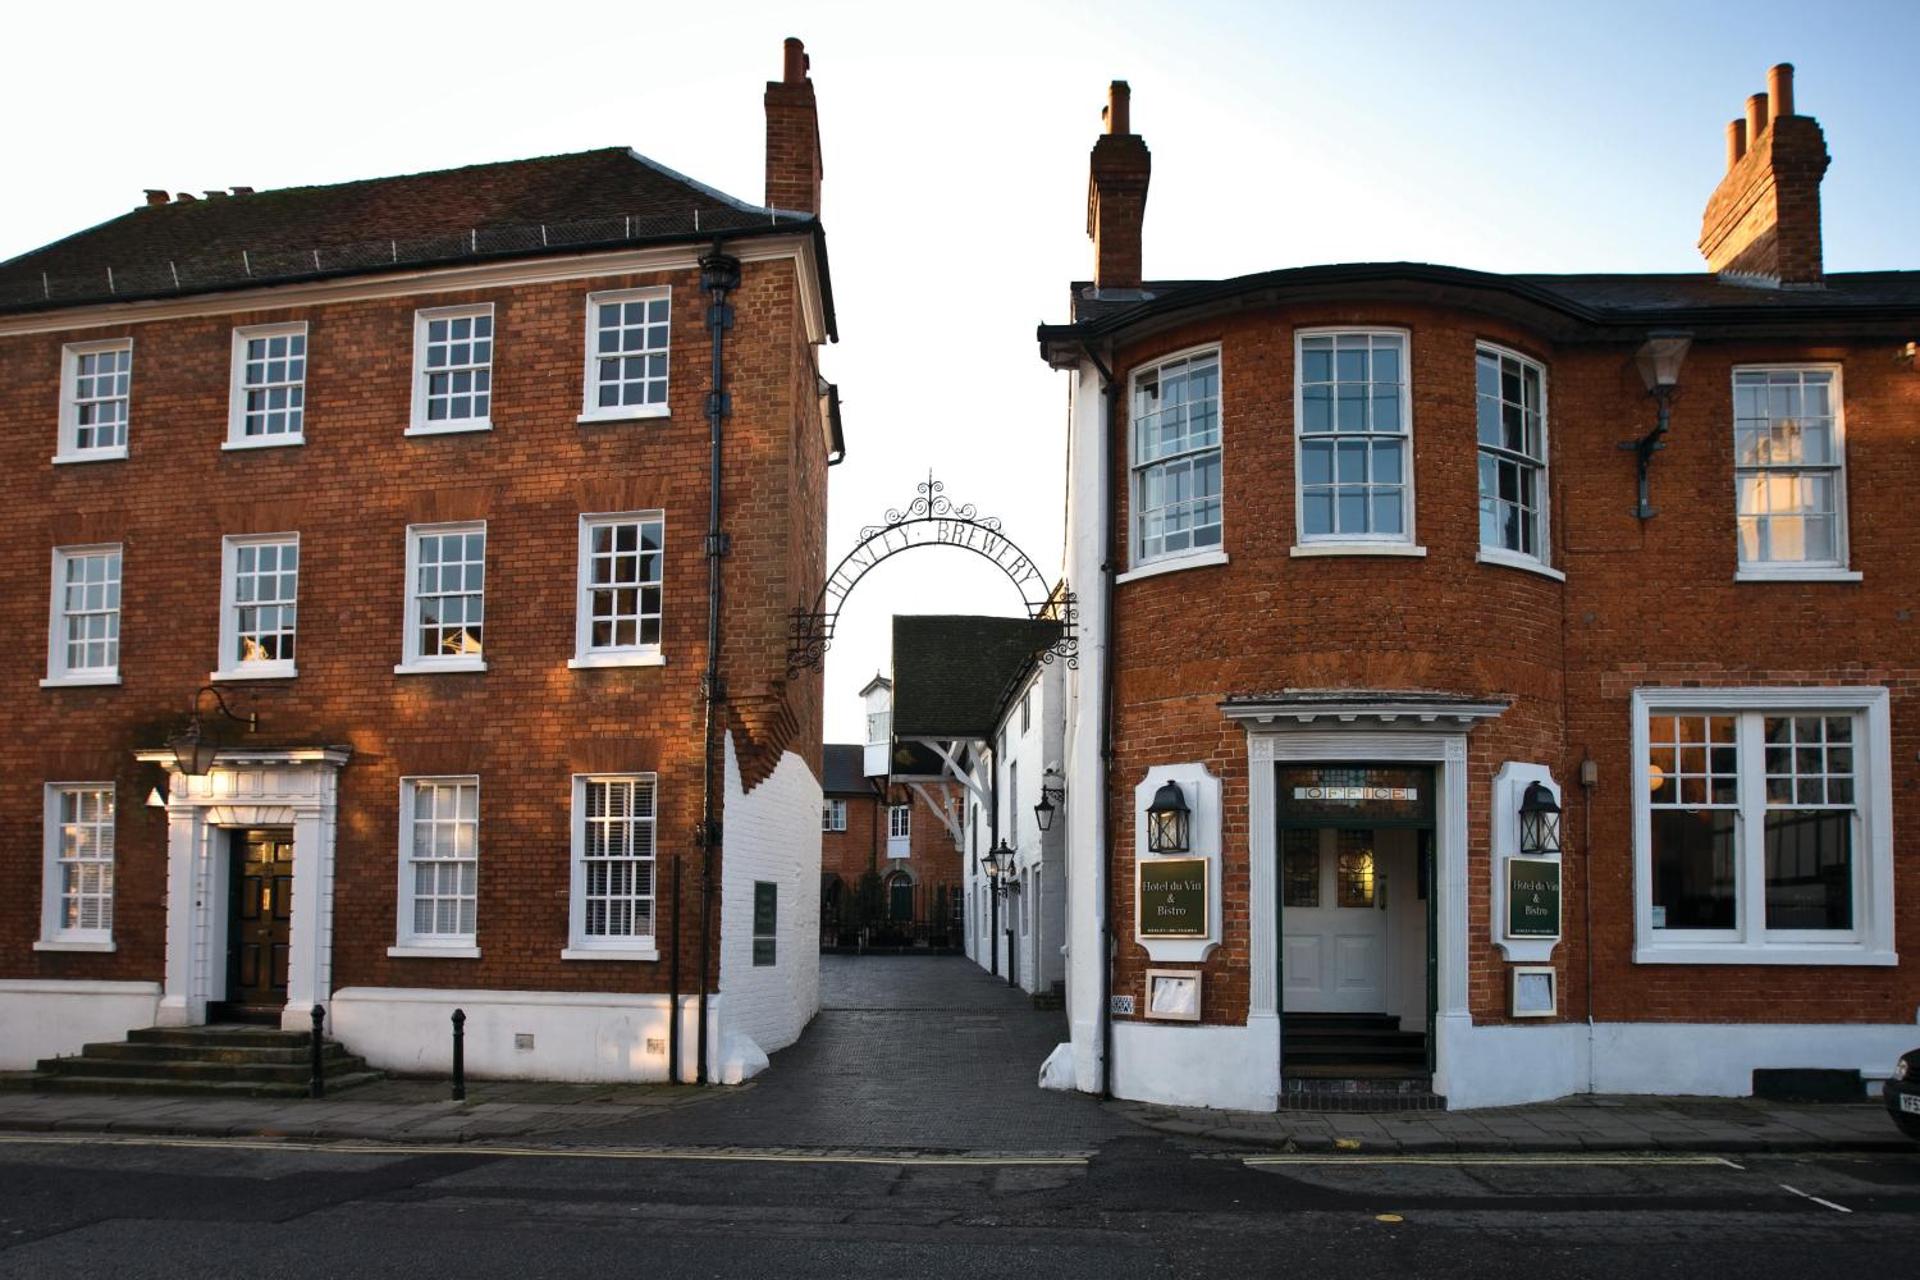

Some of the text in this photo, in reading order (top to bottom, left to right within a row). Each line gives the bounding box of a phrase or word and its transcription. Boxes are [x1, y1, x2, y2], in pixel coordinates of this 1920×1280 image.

[937, 519, 1039, 585] BREWERY
[1308, 787, 1406, 800] OFFICE
[1143, 880, 1202, 892] Hotel du Vin
[1513, 880, 1534, 891] Hotel
[1167, 893, 1176, 904] &
[1532, 893, 1540, 903] &
[1157, 905, 1187, 916] Bistro
[1525, 905, 1548, 916] Bistro
[1903, 1095, 1920, 1111] YF5
